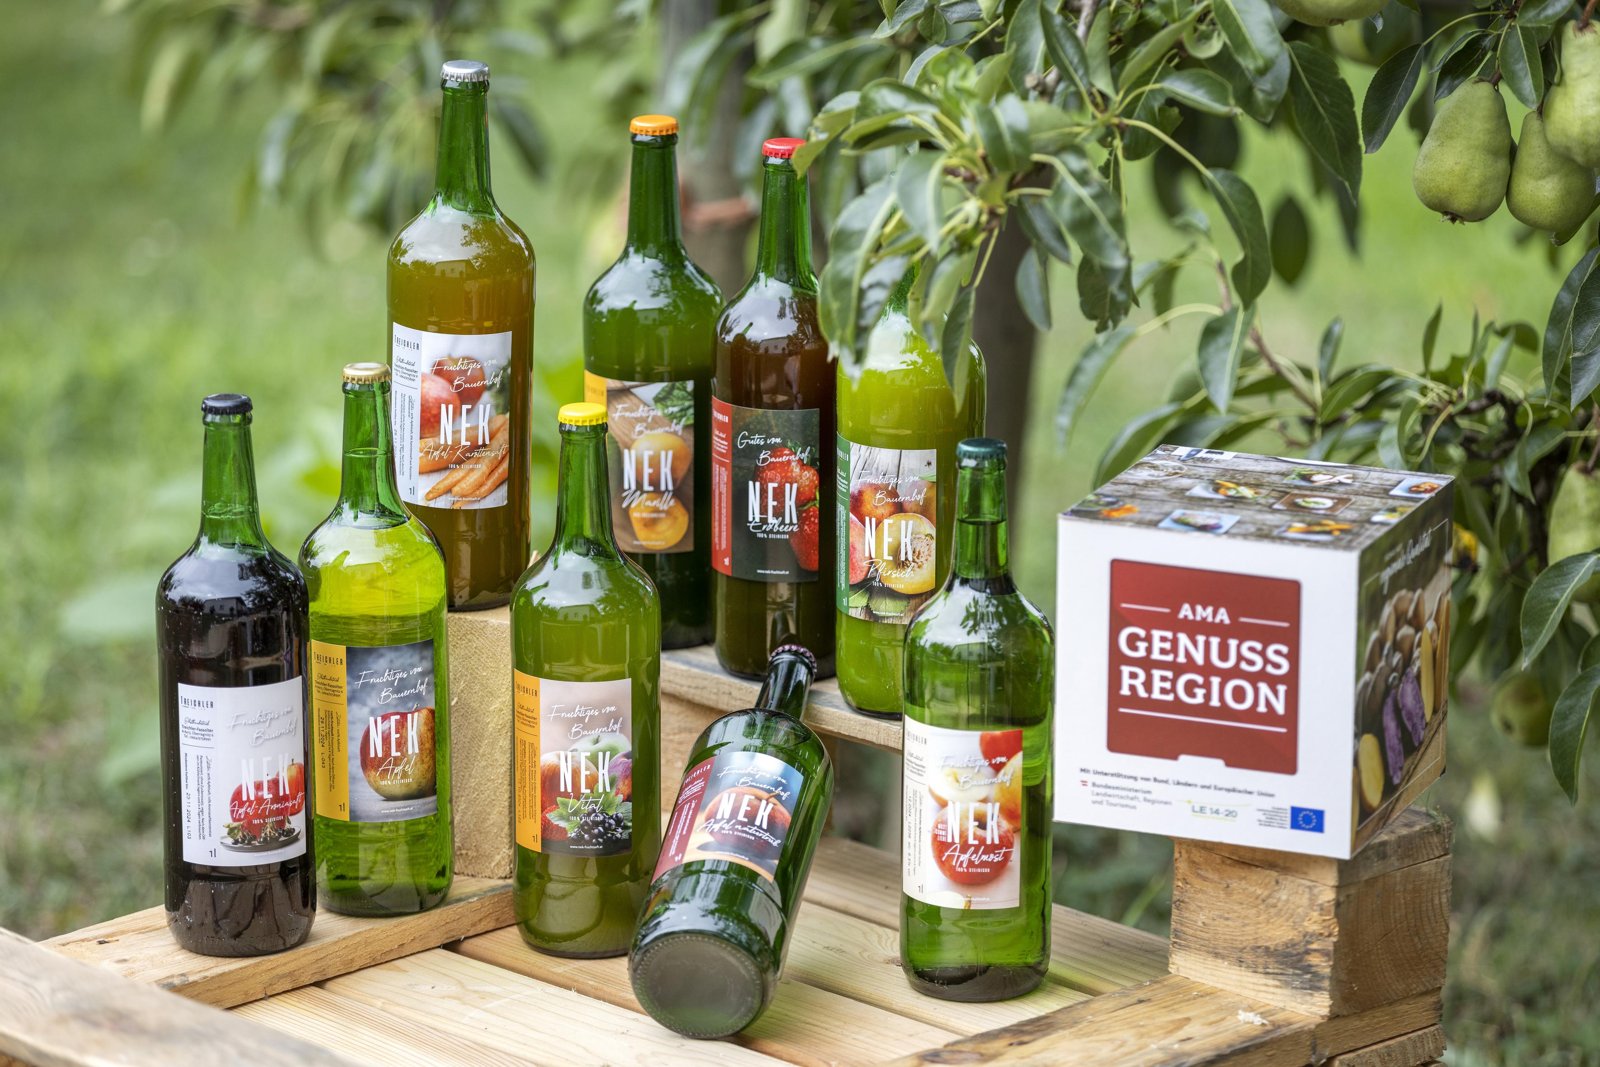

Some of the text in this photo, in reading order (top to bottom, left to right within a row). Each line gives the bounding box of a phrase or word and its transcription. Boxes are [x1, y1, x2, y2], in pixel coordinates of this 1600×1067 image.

[450, 370, 503, 393] Bauernhof
[440, 403, 491, 446] NEK
[737, 431, 766, 449] Gutes
[767, 437, 783, 445] vom
[756, 446, 811, 467] Bauernhof
[623, 448, 674, 491] NEK
[748, 480, 798, 524] NEK
[872, 488, 927, 506] Bauernhof
[746, 515, 800, 533] Erdbeere
[864, 516, 914, 562] NEK
[862, 559, 915, 582] Pfirsich
[1177, 603, 1231, 624] AMA
[1118, 626, 1290, 675] GENUSS
[355, 669, 408, 689] Fruchtiges
[409, 667, 423, 675] vom
[1119, 665, 1288, 715] REGION
[378, 677, 428, 705] Bauernhof
[548, 704, 599, 723] Fruchtiges
[601, 705, 617, 714] vom
[369, 713, 419, 758] NEK
[567, 717, 623, 740] Bauernhof
[241, 753, 290, 801] NEK
[376, 755, 416, 780] Apfel
[559, 750, 611, 793] NEK
[1093, 769, 1138, 782] Unterstützung
[1092, 782, 1152, 795] Bundesministerium
[230, 792, 305, 819] Apfel-Aroniasaft
[567, 793, 605, 813] Vital
[716, 793, 775, 829] NEK
[1192, 805, 1207, 815] LE
[697, 818, 736, 833] Apfel
[947, 801, 1000, 845] NEK
[942, 843, 1015, 870] Apfelmost
